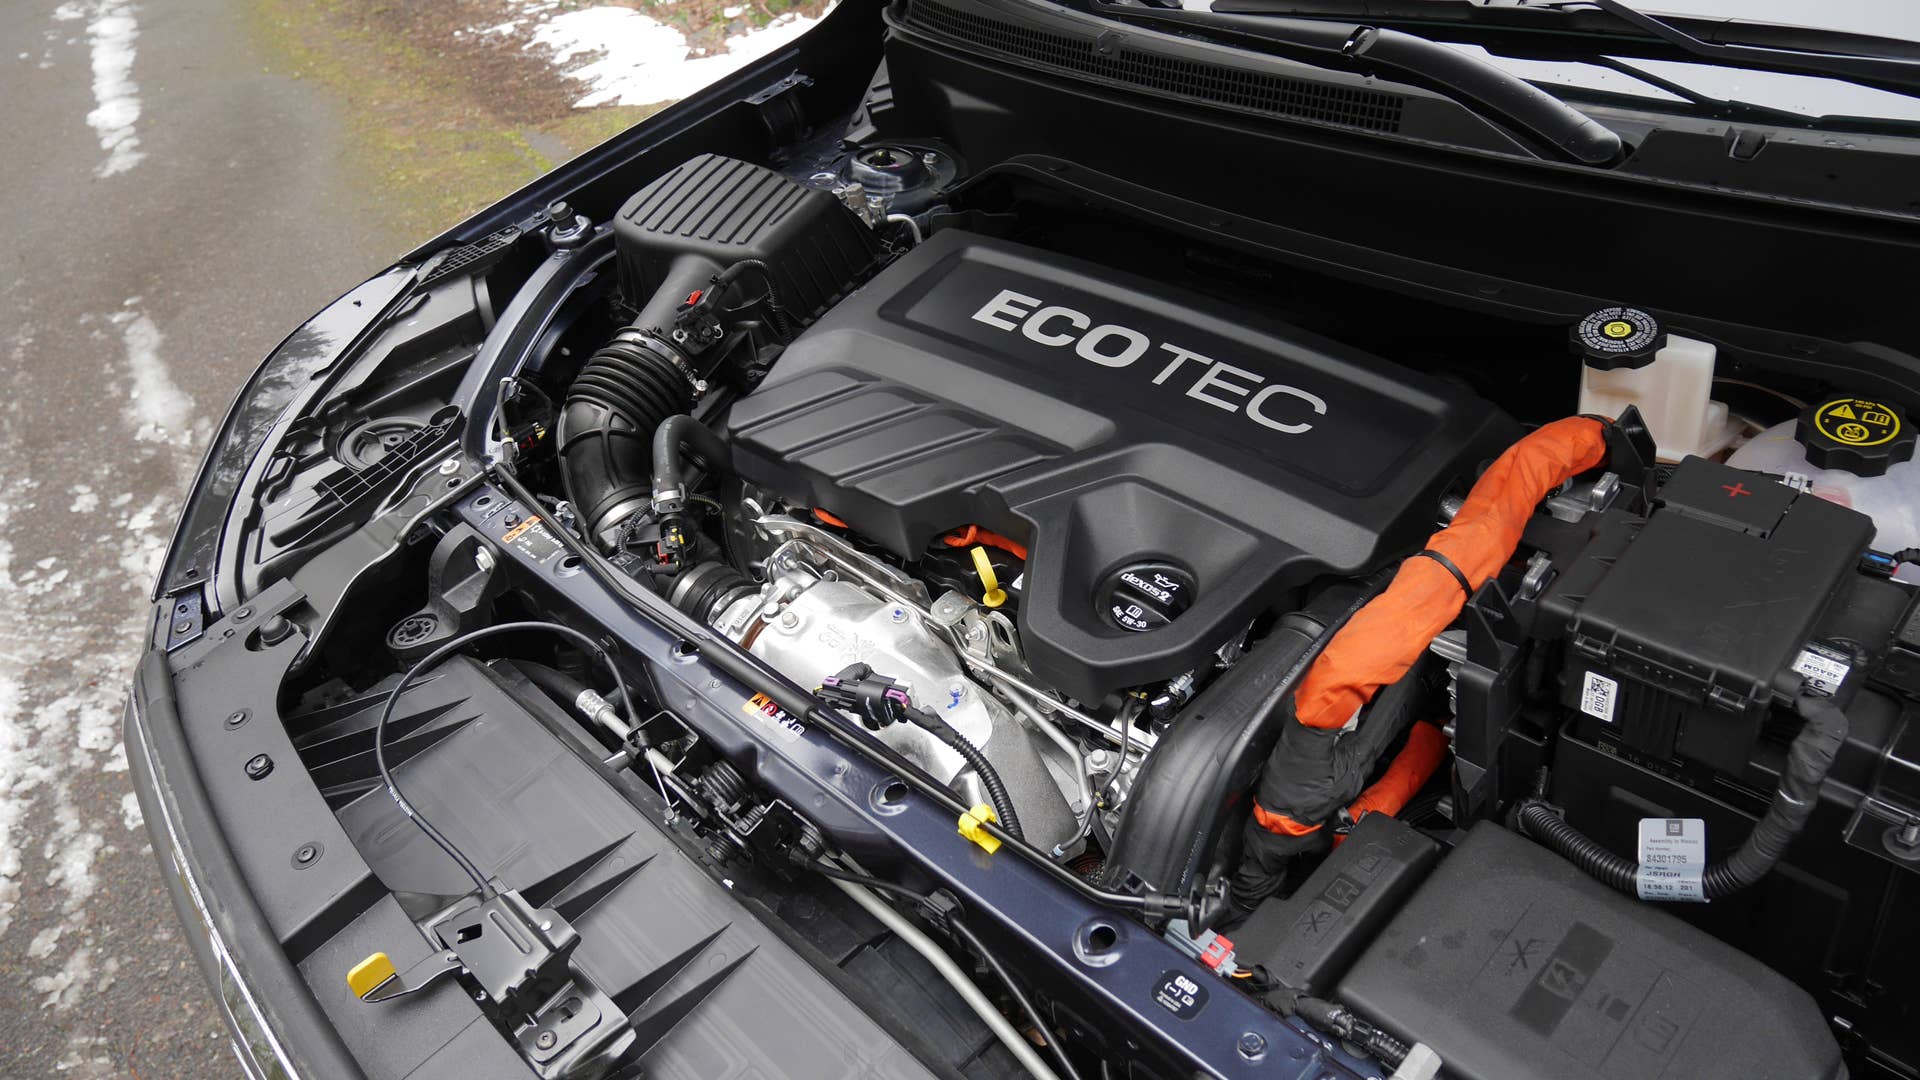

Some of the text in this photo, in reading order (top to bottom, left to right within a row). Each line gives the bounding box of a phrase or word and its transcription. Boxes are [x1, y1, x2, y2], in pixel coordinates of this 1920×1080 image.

[971, 289, 1327, 434] ECOTEC
[1121, 615, 1147, 628] 5W-30
[1174, 975, 1199, 996] GND
